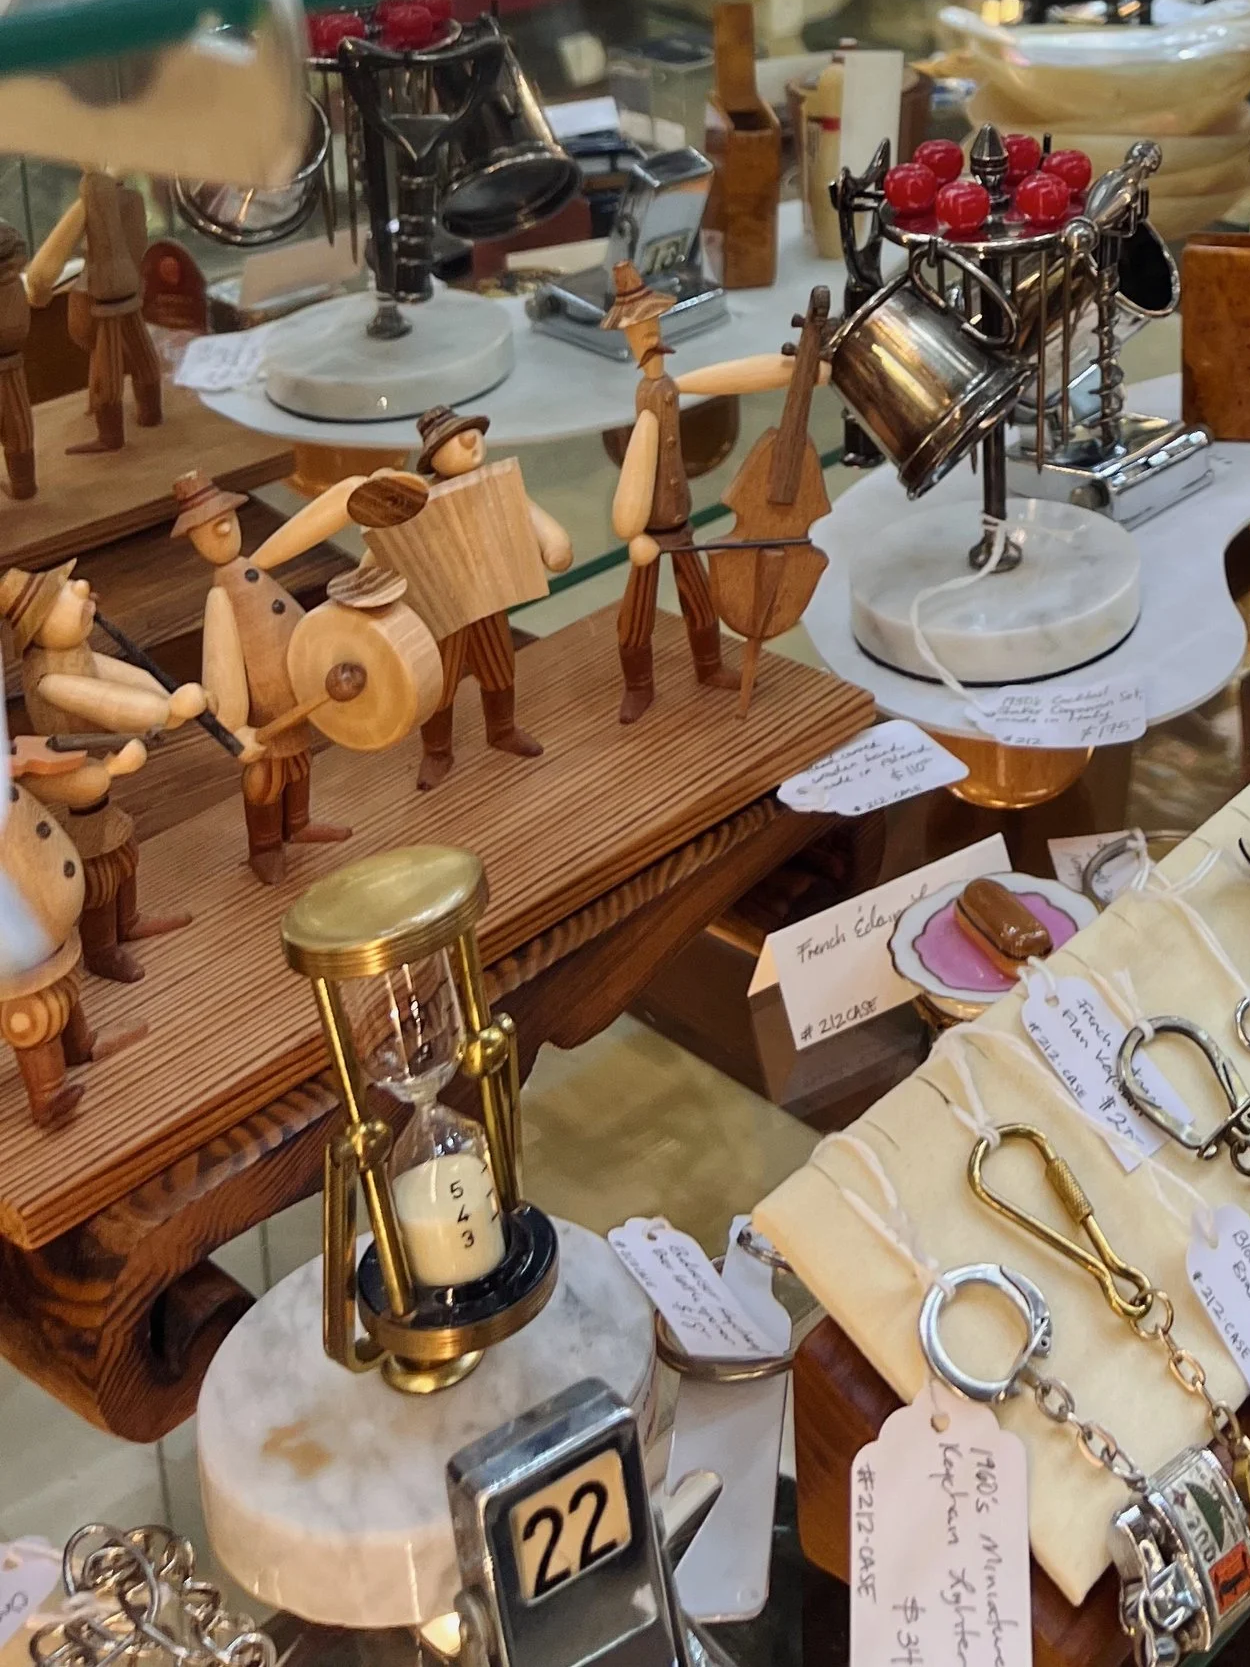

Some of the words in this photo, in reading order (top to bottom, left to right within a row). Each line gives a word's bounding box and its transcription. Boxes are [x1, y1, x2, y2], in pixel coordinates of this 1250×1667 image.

[796, 923, 847, 964] French
[818, 995, 879, 1035] 212CASE
[1061, 1009, 1090, 1050] Flan
[1075, 997, 1112, 1048] French
[449, 1179, 464, 1200] 5
[456, 1204, 470, 1225] 4
[460, 1229, 475, 1249] 3
[969, 1446, 999, 1514] 1960's
[522, 1478, 619, 1599] 22
